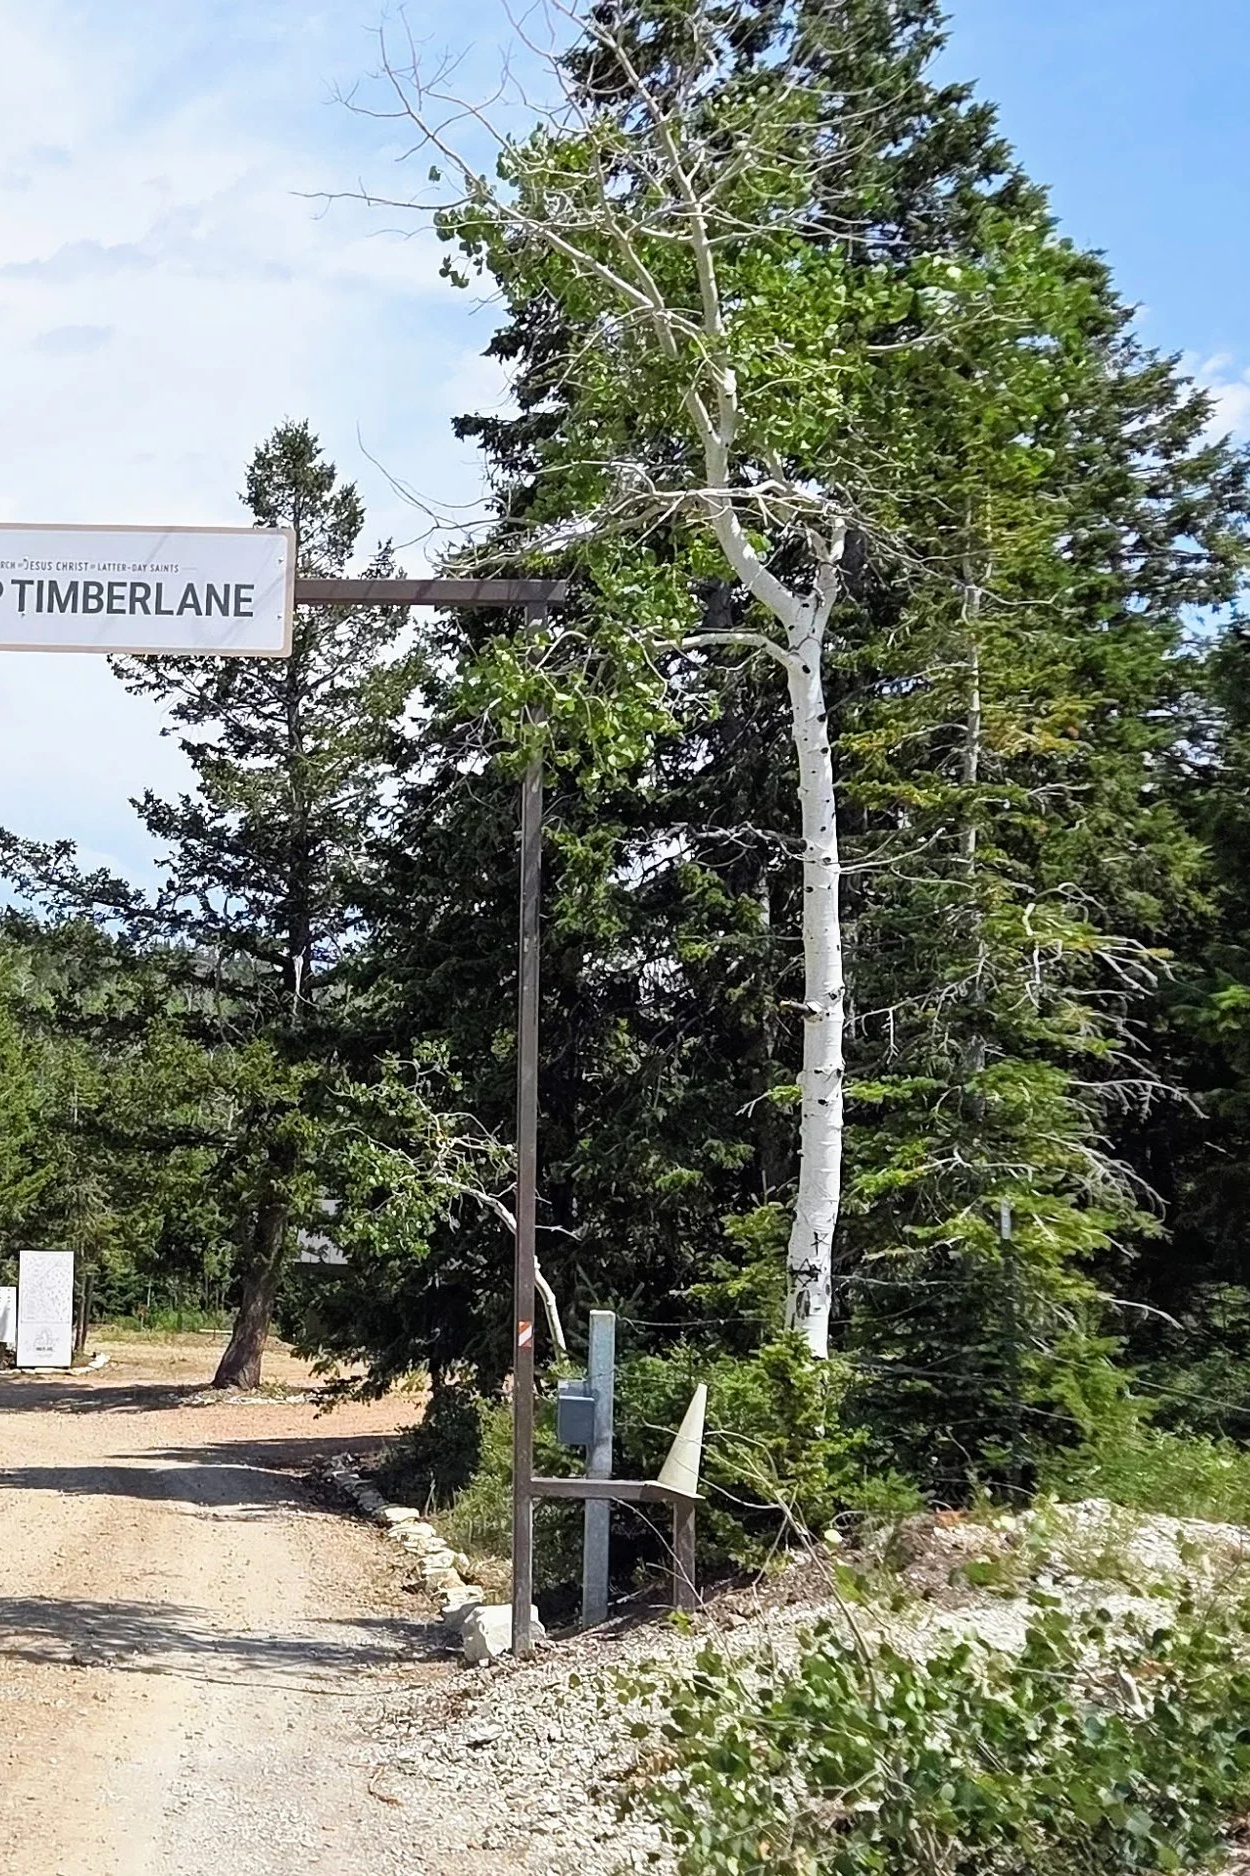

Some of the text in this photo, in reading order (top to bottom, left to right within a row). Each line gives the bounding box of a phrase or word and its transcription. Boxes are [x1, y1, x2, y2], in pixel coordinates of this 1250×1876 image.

[23, 559, 53, 571] JESUS
[56, 561, 89, 571] CHRIST
[97, 562, 147, 572] LATTER-DAY
[150, 564, 179, 573] SAINTS
[11, 579, 255, 617] TIMBERLANE
